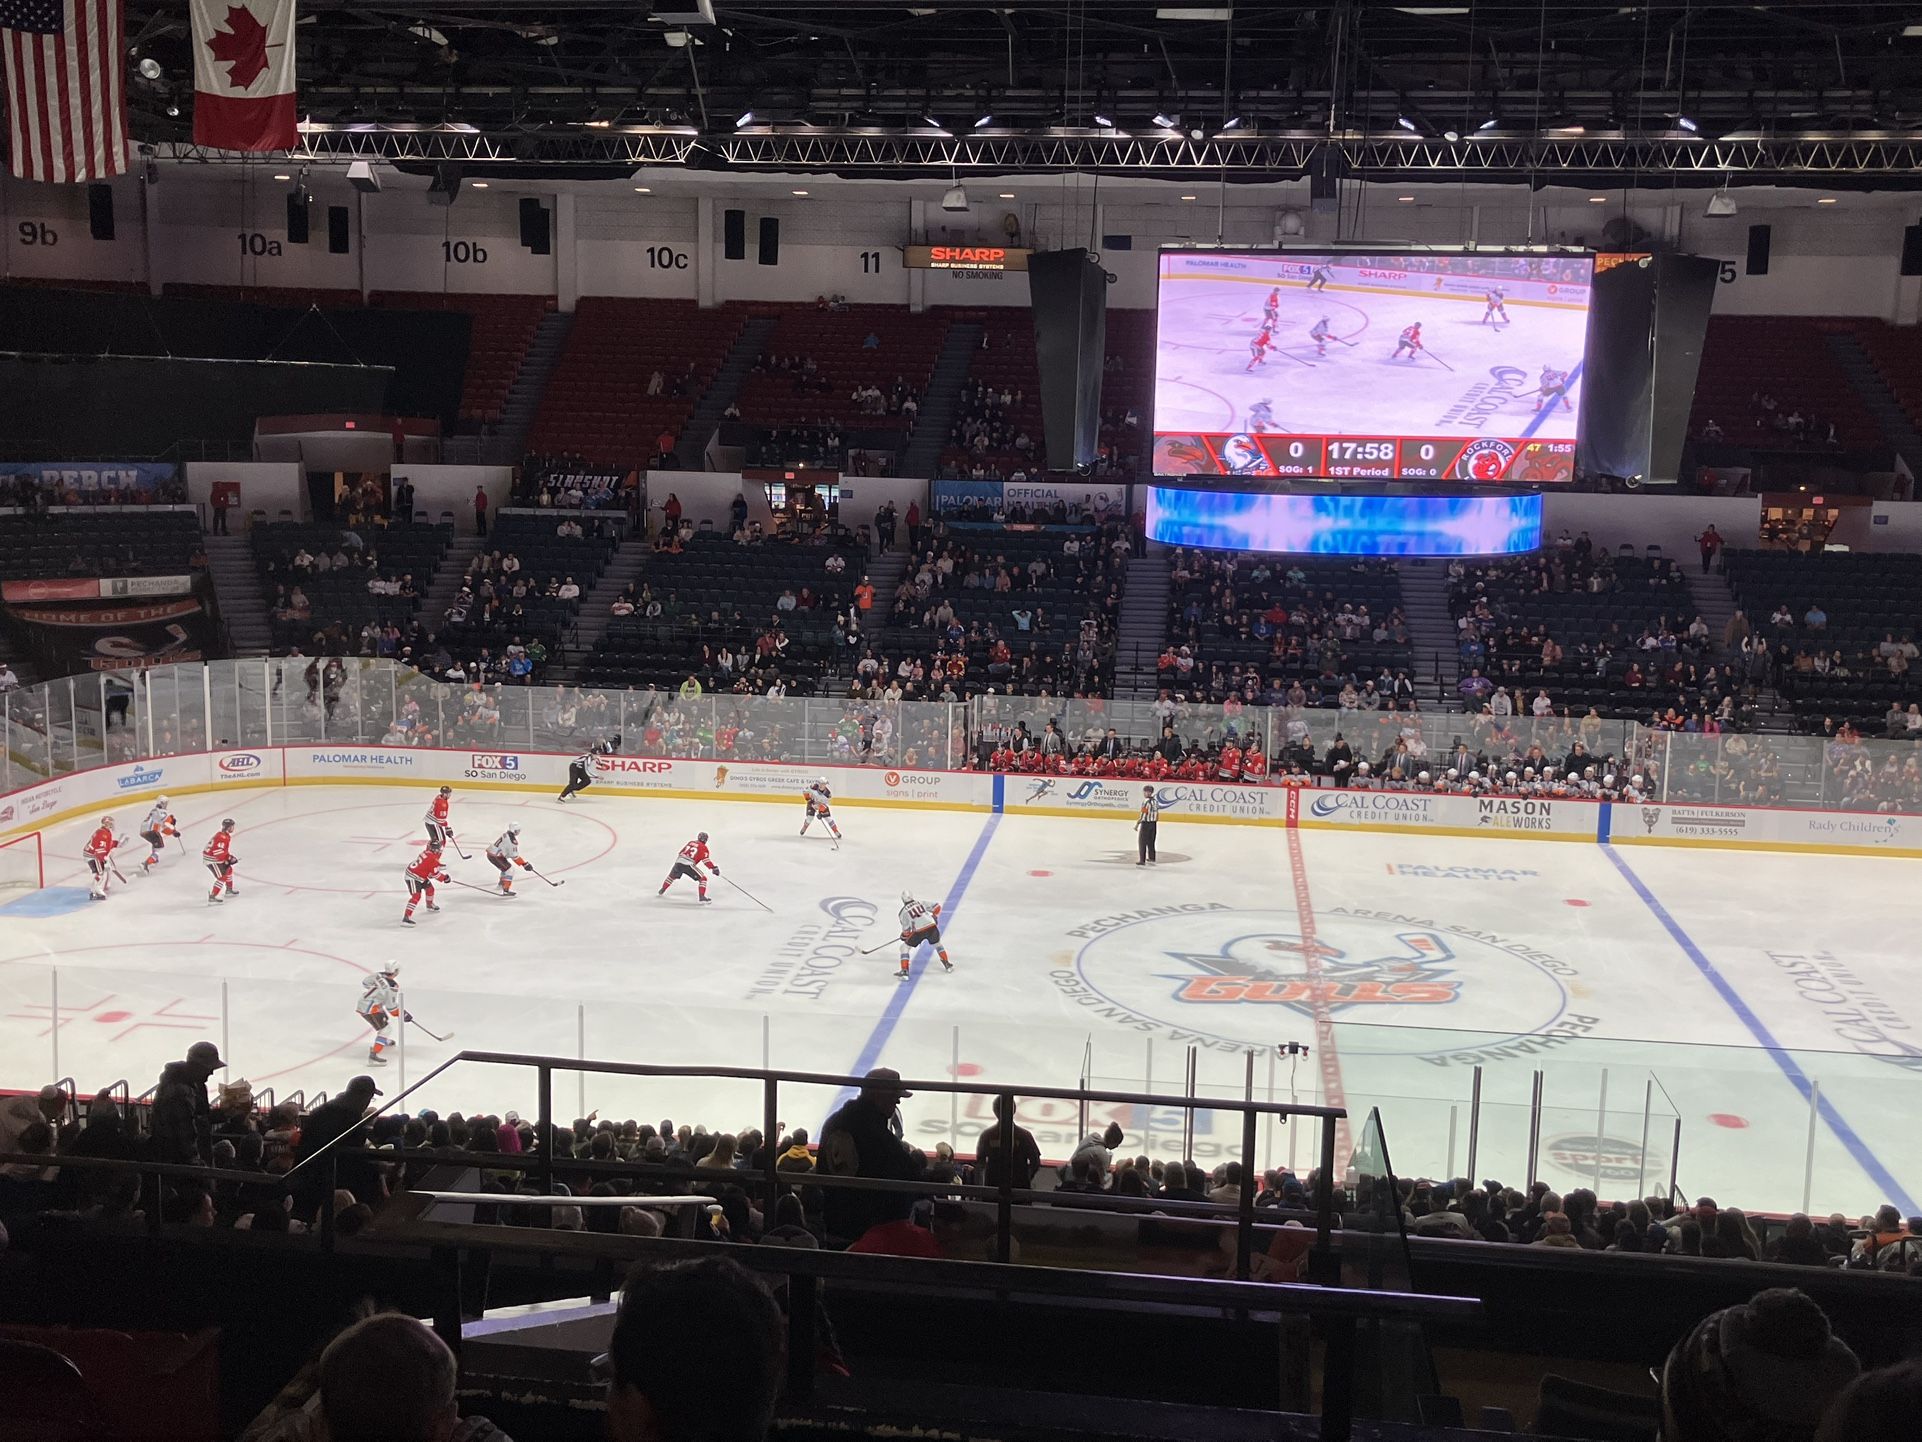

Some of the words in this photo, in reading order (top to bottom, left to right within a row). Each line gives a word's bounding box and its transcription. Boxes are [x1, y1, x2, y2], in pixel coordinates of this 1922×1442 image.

[18, 222, 58, 248] 9b
[238, 233, 283, 258] 10a
[442, 241, 488, 265] 10b
[646, 246, 689, 270] 10c
[931, 247, 1005, 261] SHARP
[860, 252, 881, 274] 11
[1282, 264, 1300, 273] FOX
[952, 270, 964, 280] NO
[966, 270, 1003, 280] SMOKING
[1359, 269, 1407, 281] SHARP
[1289, 442, 1304, 458] 0
[1327, 442, 1394, 461] 17:58
[1419, 444, 1434, 461] 0
[1526, 444, 1541, 452] 47
[1548, 444, 1573, 453] 1:55
[1279, 465, 1303, 474] SOG:
[1307, 465, 1313, 474] 1
[1328, 467, 1351, 476] 1ST
[1353, 466, 1389, 477] Period
[1401, 467, 1426, 476] SOG:
[1429, 468, 1437, 476] 0
[41, 470, 138, 491] PERCH
[1007, 488, 1060, 499] OFFICIAL
[101, 611, 128, 623] OF
[138, 605, 177, 619] THE
[226, 755, 254, 768] AHL
[312, 754, 368, 764] PALOMAR
[370, 754, 413, 765] HEALTH
[473, 755, 502, 769] FOX
[506, 756, 516, 770] 5
[596, 759, 673, 774] SHARP
[220, 771, 261, 780] TheAHL.com
[464, 769, 479, 778] SO
[480, 770, 497, 779] San
[499, 771, 527, 782] Diego
[901, 774, 941, 786] GROUP
[886, 788, 910, 799] signs
[917, 789, 939, 799] print
[1094, 788, 1129, 797] SYNERGY
[1175, 786, 1206, 802] CAL
[1209, 787, 1268, 805] COAST
[1188, 802, 1226, 813] CREDIT
[1231, 803, 1266, 815] UNION
[1335, 792, 1369, 809] CAL
[1372, 794, 1432, 812] COAST
[1479, 799, 1552, 816] MASON
[1350, 810, 1388, 821] CREDIT
[1394, 812, 1429, 823] UNION
[1492, 816, 1552, 830] ALEWORKS
[1676, 826, 1697, 834] (619)
[1699, 826, 1738, 837] 333-5555
[1808, 819, 1837, 833] Rady
[1398, 864, 1539, 876] PALOMAR
[1399, 870, 1518, 881] HEALTH
[822, 914, 876, 942] CAL
[777, 923, 822, 957] CREDIT
[1065, 900, 1234, 939] PECHANGA
[1328, 906, 1435, 927] ARENA
[1443, 924, 1507, 944] SAN
[1503, 943, 1579, 977] DIEGO
[782, 944, 856, 1000] COAST
[1763, 950, 1848, 1005] COAST
[1048, 968, 1107, 1007] DIEGO
[1178, 975, 1462, 1004] GULLS
[1094, 1007, 1164, 1033] SAN
[1821, 1007, 1888, 1043] CAL
[1415, 1012, 1601, 1067] PECHANGA
